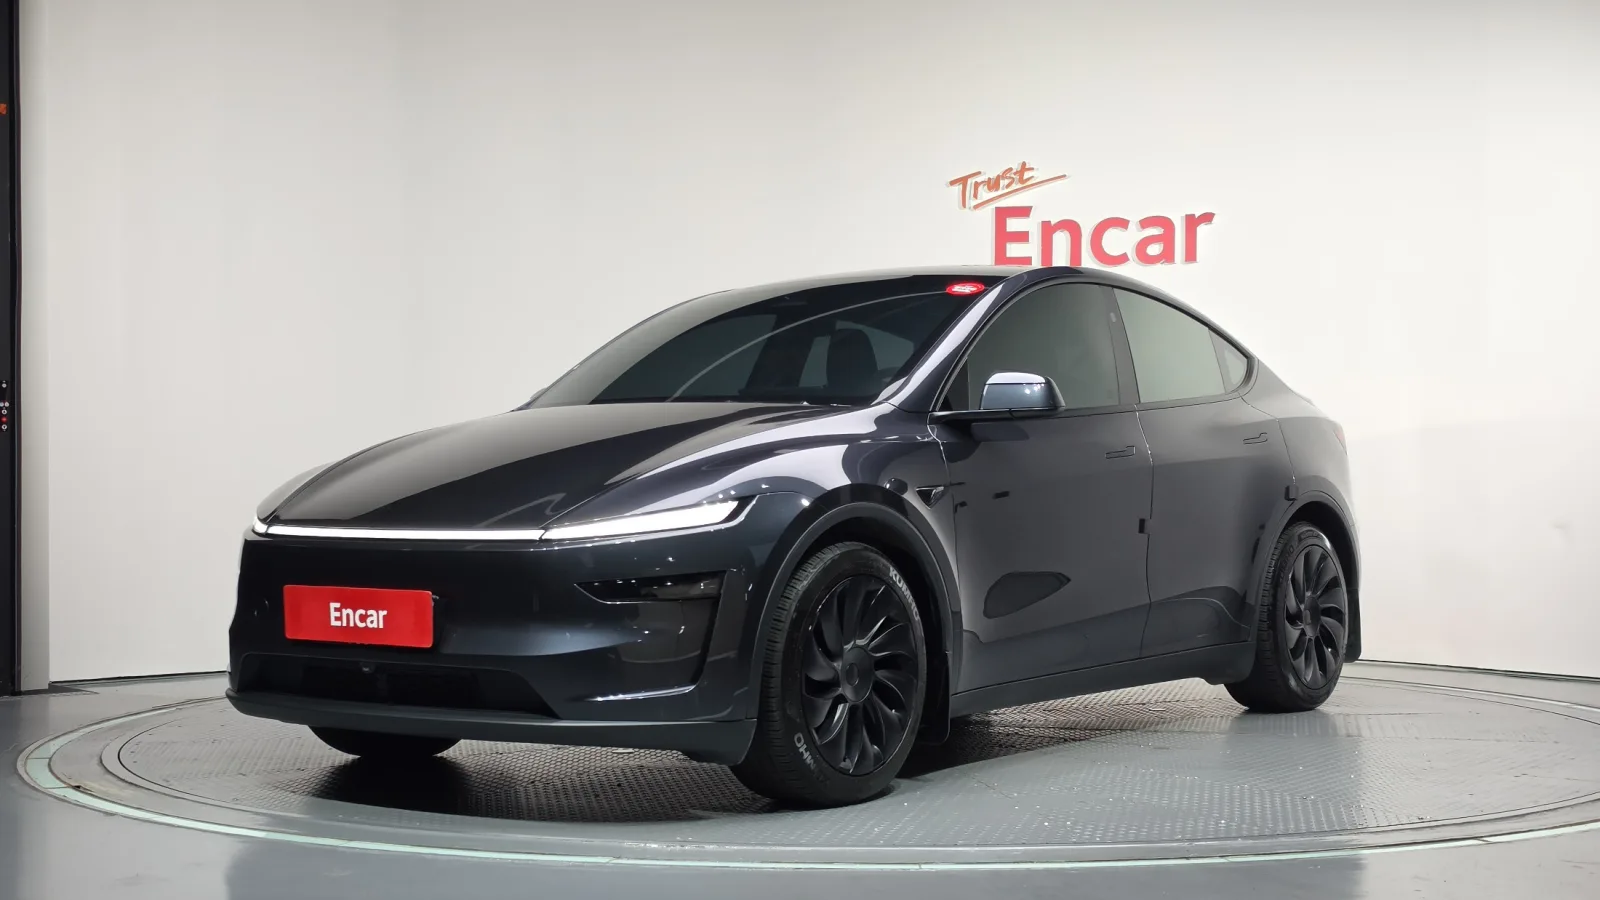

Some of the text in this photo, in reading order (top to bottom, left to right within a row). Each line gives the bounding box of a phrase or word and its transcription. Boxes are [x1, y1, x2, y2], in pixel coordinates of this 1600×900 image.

[949, 161, 1035, 208] Trust
[995, 206, 1216, 267] Encar
[329, 602, 388, 628] Encar
[889, 566, 919, 620] KUMHO
